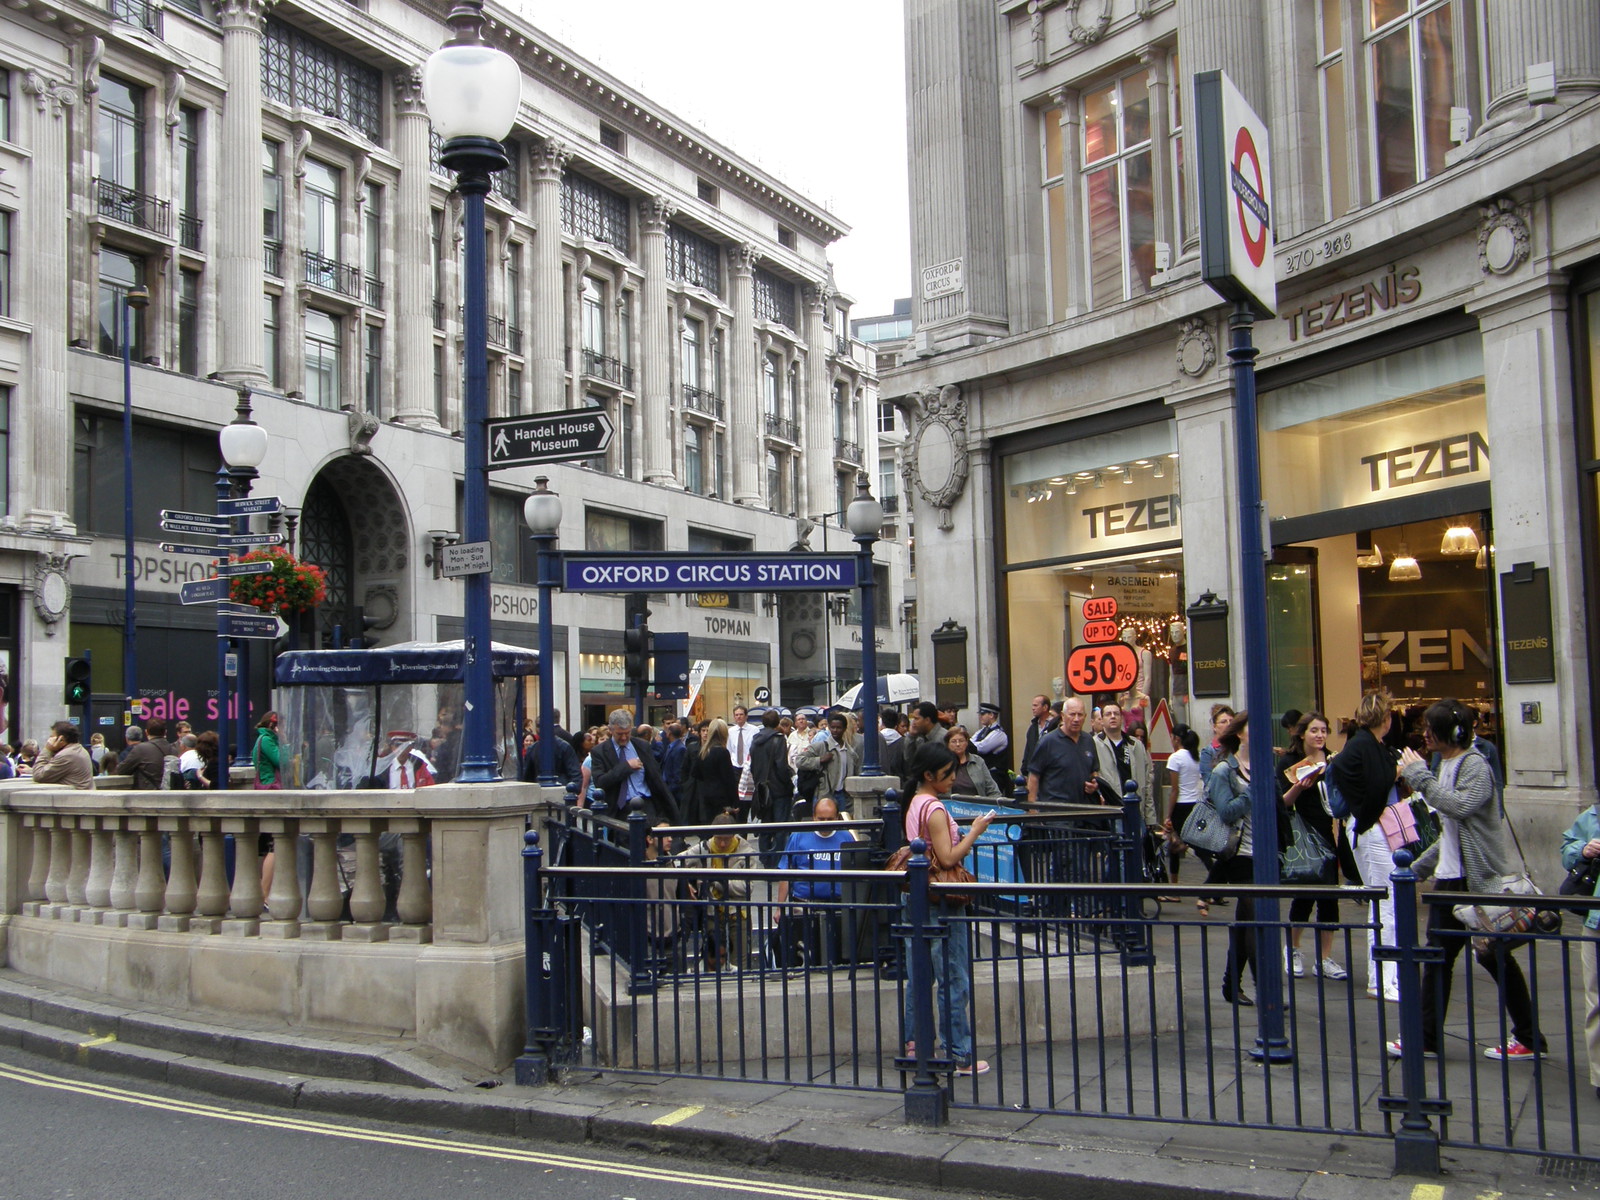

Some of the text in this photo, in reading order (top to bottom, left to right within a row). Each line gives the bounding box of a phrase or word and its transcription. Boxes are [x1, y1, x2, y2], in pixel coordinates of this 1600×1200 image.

[1231, 171, 1268, 222] UNDERGROUND
[1286, 232, 1351, 274] 270-266
[925, 264, 953, 280] OXFORD
[925, 276, 950, 291] CIRCUS
[1282, 264, 1421, 341] TEZENIS
[515, 422, 595, 440] Handel House
[531, 439, 579, 452] Museum
[1361, 432, 1489, 491] TEZEN
[191, 525, 217, 533] COLLECTION
[460, 546, 484, 554] loading
[582, 564, 841, 583] OXFORD CIRCUS STATION
[1108, 576, 1159, 586] BASEMENT
[493, 594, 537, 616] PSHOP
[1088, 602, 1113, 616] SALE
[705, 617, 750, 636] TOPMAN
[1086, 625, 1115, 638] UP TO
[1508, 636, 1547, 650] TEZENIS
[1073, 653, 1131, 686] -50%
[1194, 658, 1226, 669] TEZENIS
[756, 690, 768, 699] JD
[139, 691, 190, 720] sale
